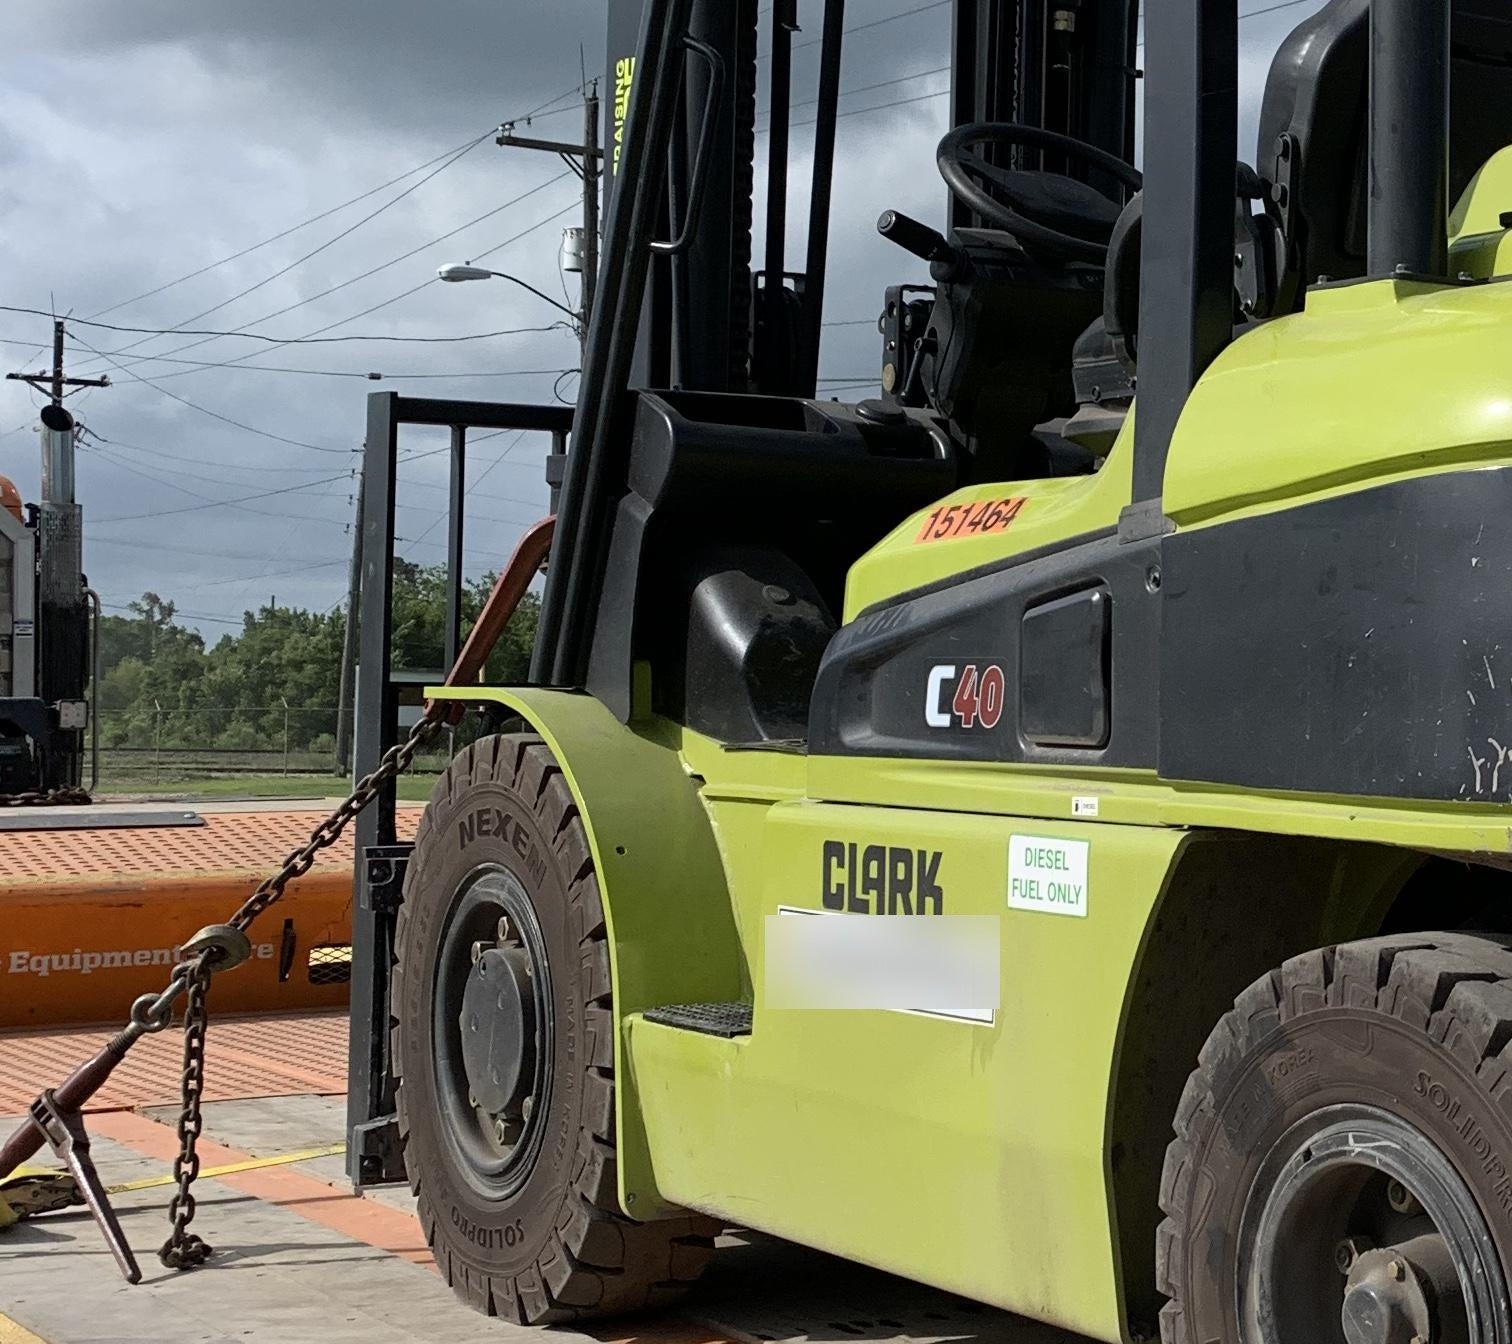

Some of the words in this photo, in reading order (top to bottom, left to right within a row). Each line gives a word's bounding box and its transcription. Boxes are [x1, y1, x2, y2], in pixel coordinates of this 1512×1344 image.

[922, 497, 1029, 540] 151464
[925, 665, 1005, 729] C40
[459, 808, 547, 890] NEXEN
[1024, 847, 1070, 871] DIESEL
[822, 840, 943, 916] CLARK
[1012, 877, 1044, 901] FUEL
[1047, 882, 1082, 905] ONLY
[452, 1206, 525, 1249] SOLIDPRO
